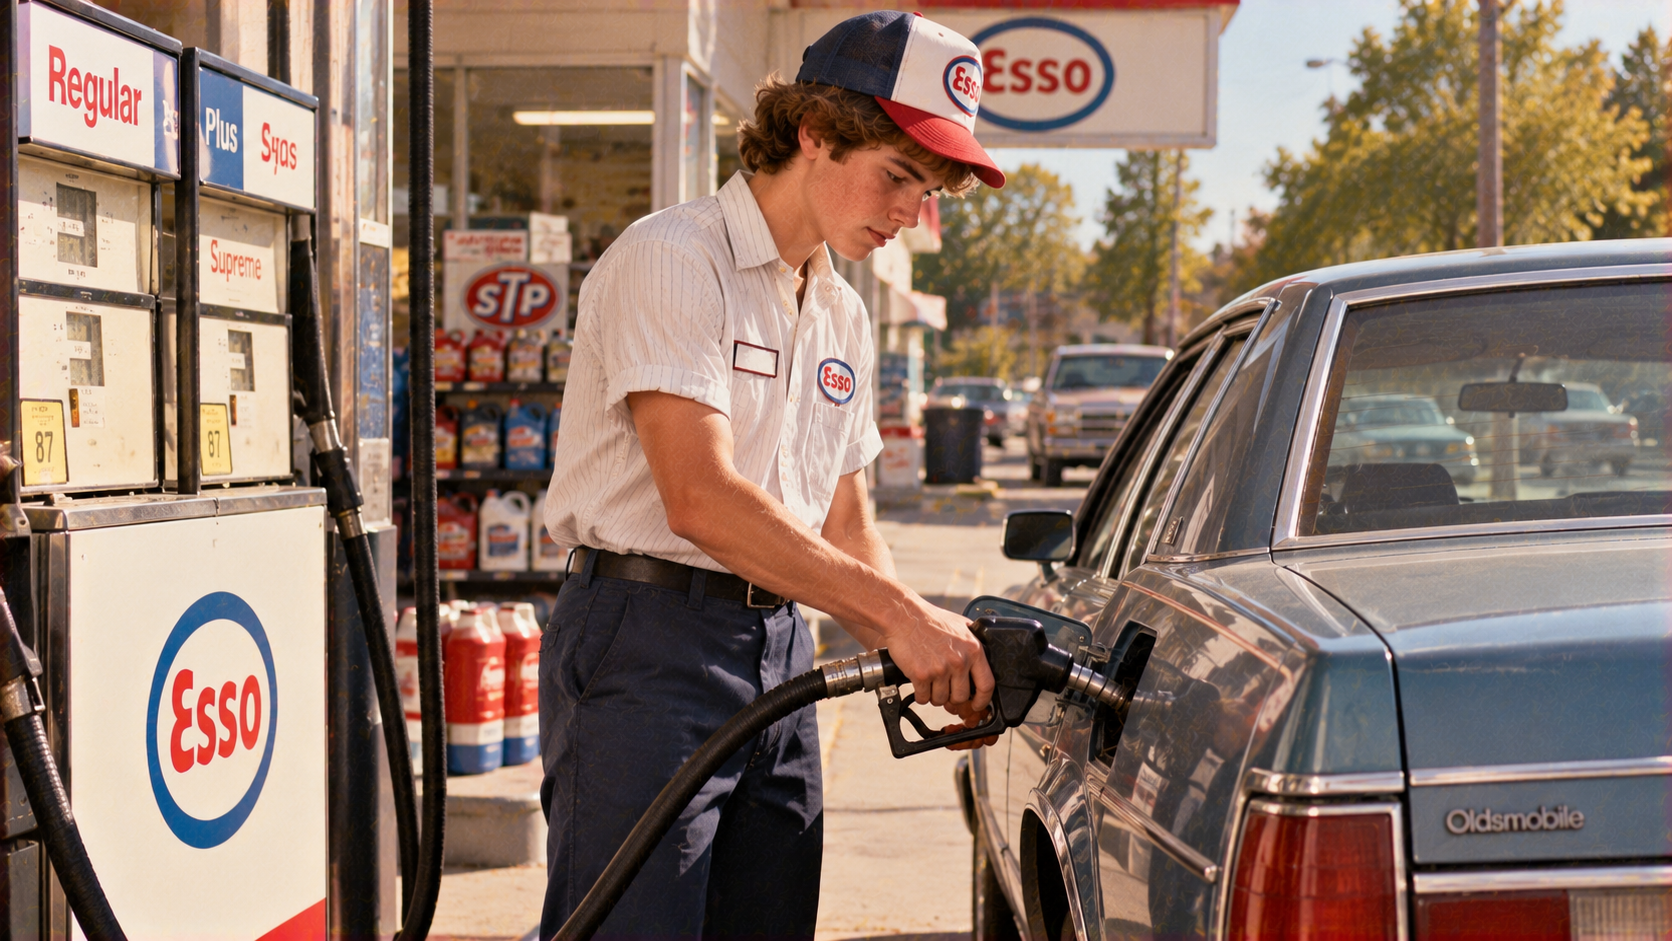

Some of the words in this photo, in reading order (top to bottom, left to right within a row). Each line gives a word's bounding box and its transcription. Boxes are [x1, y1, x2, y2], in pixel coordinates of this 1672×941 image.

[48, 44, 142, 128] Regular
[982, 47, 1092, 95] Esso
[205, 106, 238, 153] Plus
[210, 239, 262, 283] Supreme
[473, 272, 550, 323] STP
[823, 365, 852, 393] Esso
[35, 430, 54, 464] 87
[207, 429, 221, 459] 87
[170, 668, 262, 774] Esso
[1445, 804, 1585, 835] Oldsmobile
